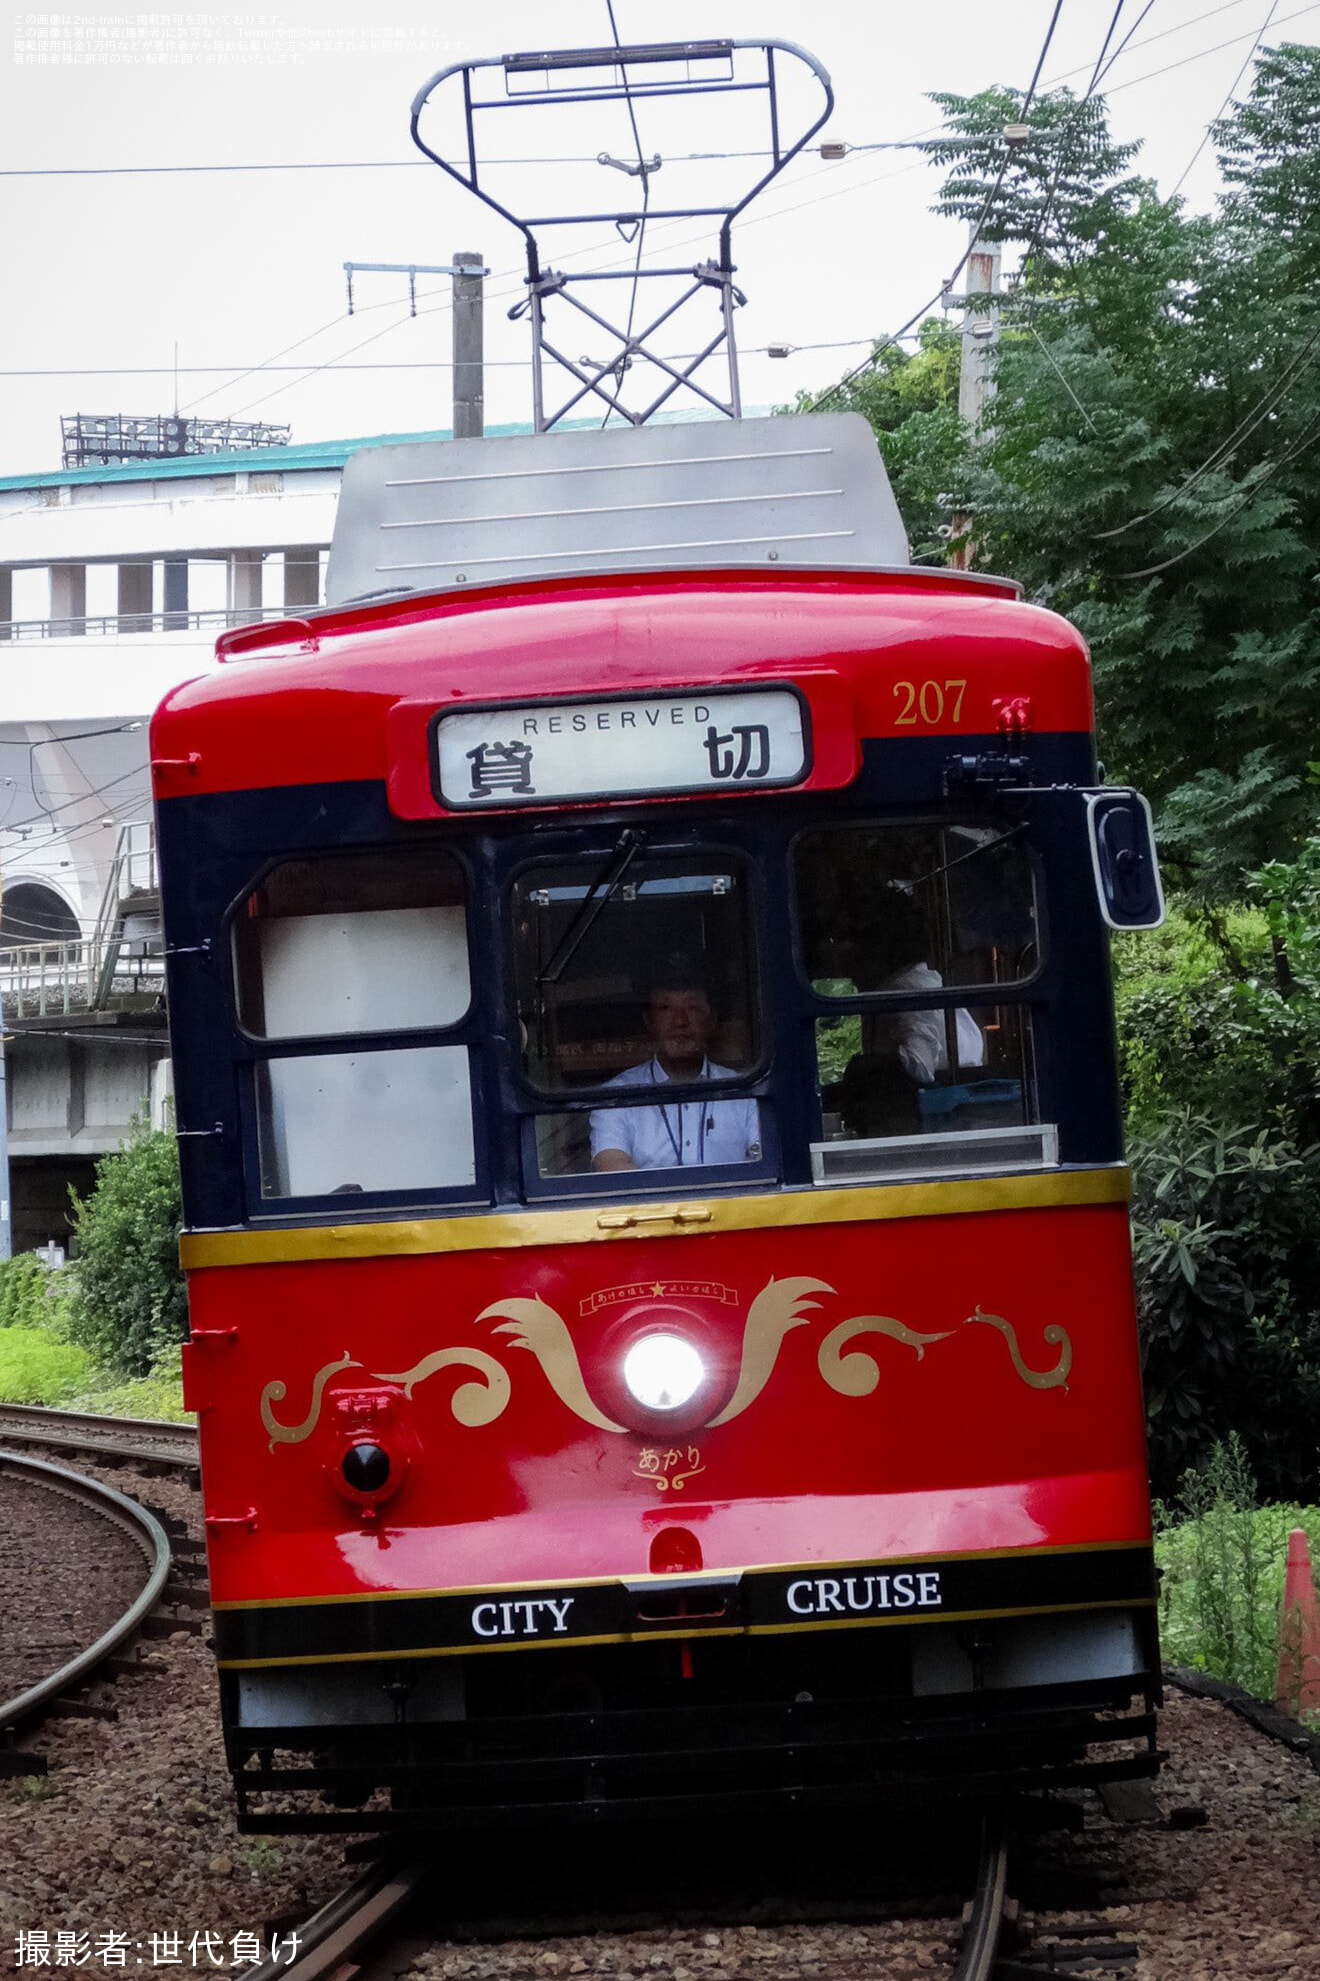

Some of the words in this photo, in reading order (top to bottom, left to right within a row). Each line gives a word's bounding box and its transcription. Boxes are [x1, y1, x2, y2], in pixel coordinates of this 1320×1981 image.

[523, 705, 712, 735] RESERVED
[892, 679, 968, 726] 207
[638, 1445, 701, 1473] あかり
[471, 1598, 575, 1637] CITY
[786, 1572, 943, 1615] CRUISE
